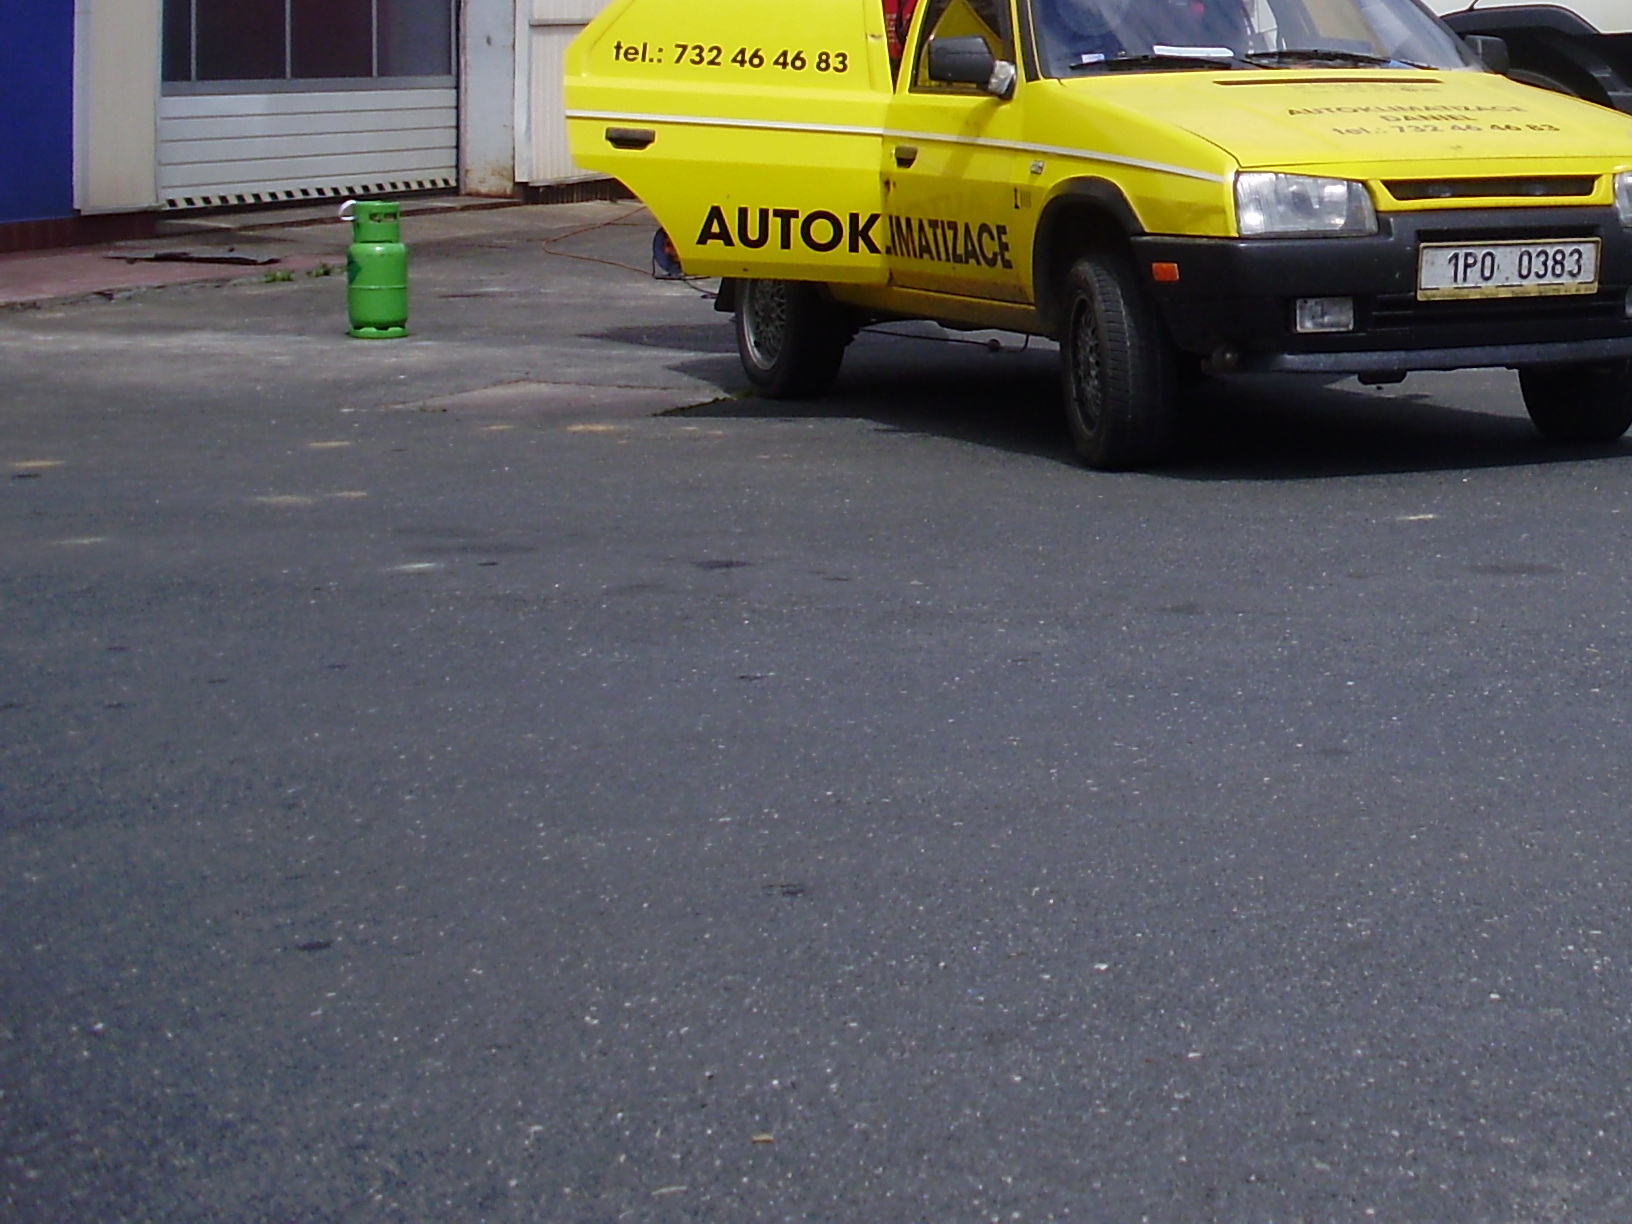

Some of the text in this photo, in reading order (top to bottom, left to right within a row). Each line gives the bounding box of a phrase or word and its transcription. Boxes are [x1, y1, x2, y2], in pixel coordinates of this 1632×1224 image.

[613, 40, 849, 73] tel.: 732 46 46 83
[1392, 124, 1445, 134] 732
[1517, 247, 1583, 279] 0383
